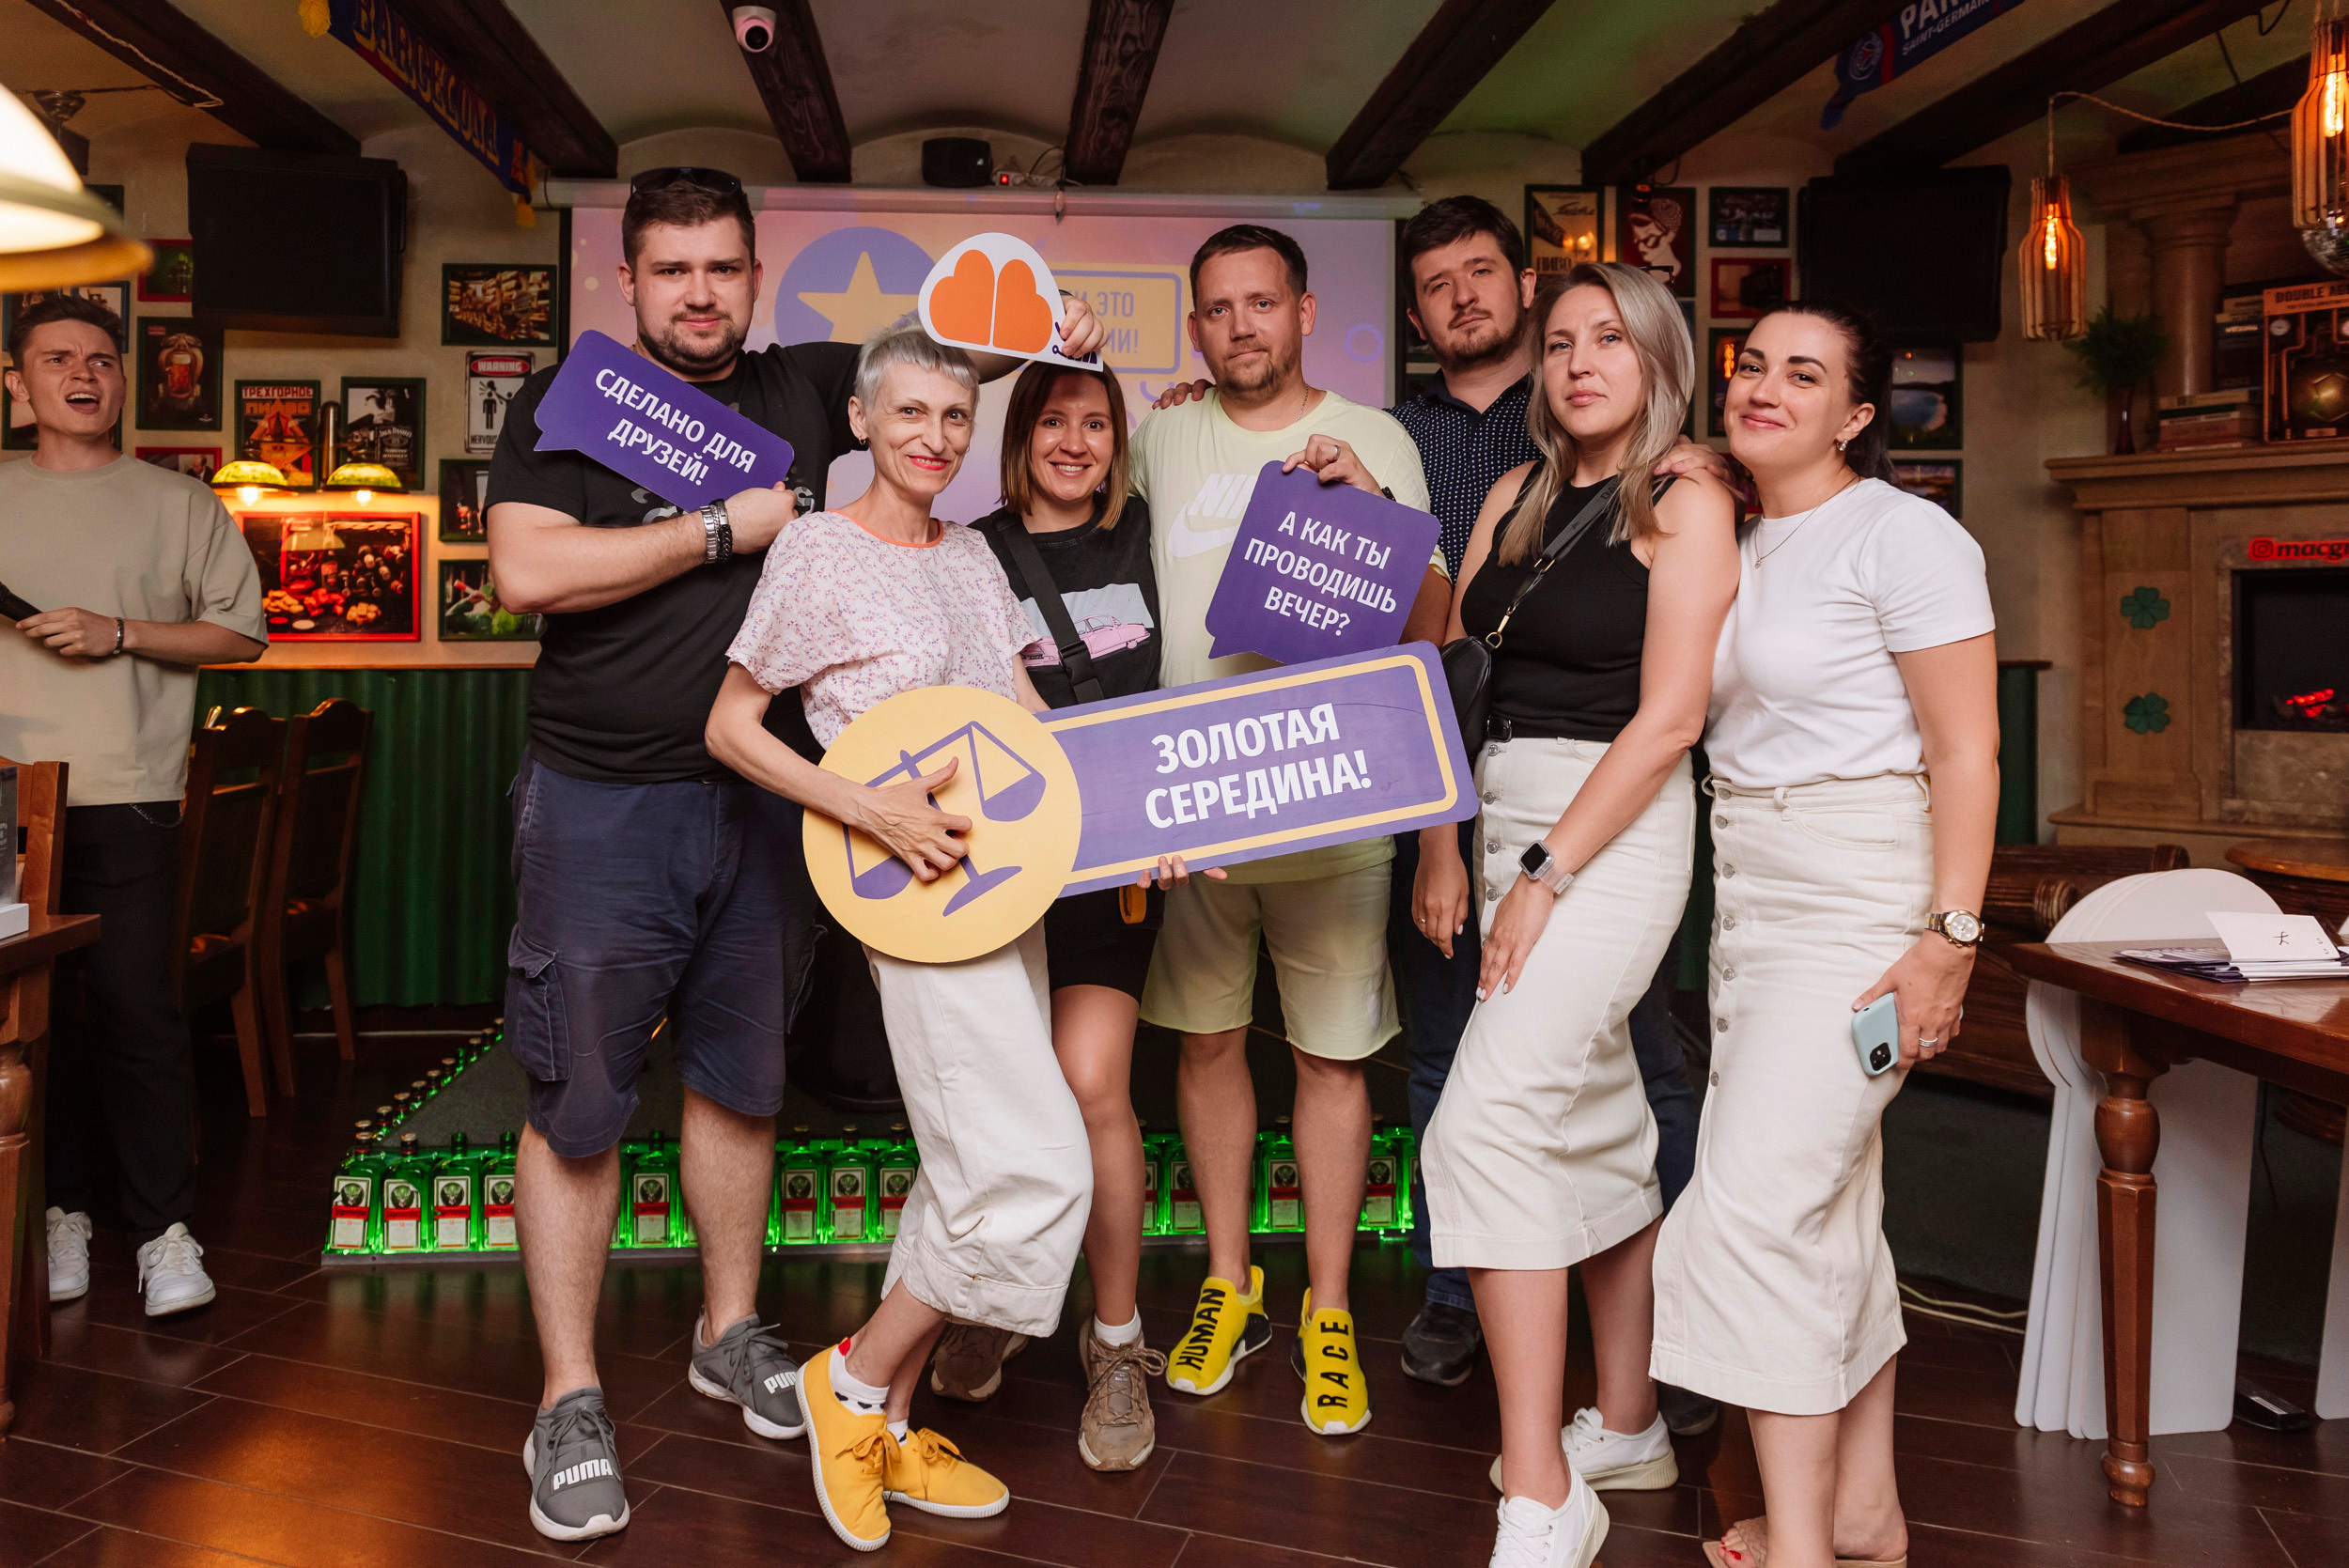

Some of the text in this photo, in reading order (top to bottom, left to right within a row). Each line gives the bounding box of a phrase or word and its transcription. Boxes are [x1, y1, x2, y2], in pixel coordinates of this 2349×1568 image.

[1097, 291, 1134, 318] ЭТО
[477, 361, 522, 372] WARNING
[595, 368, 757, 474] СДЕЛАНО ДЛЯ
[607, 418, 709, 486] ДРУЗЕЙ!
[1278, 511, 1392, 569] А КАК ТЫ
[1244, 537, 1397, 613] ПРОВОДИШЬ
[1264, 585, 1351, 636] ВЕЧЕР?
[1151, 703, 1340, 774] ЗОЛОТАЯ
[1145, 749, 1372, 829] СЕРЕДИНА!
[1175, 1288, 1225, 1371] HUMAN
[763, 1371, 797, 1395] PUM
[1317, 1321, 1349, 1408] RACE
[552, 1458, 614, 1491] PUMA
